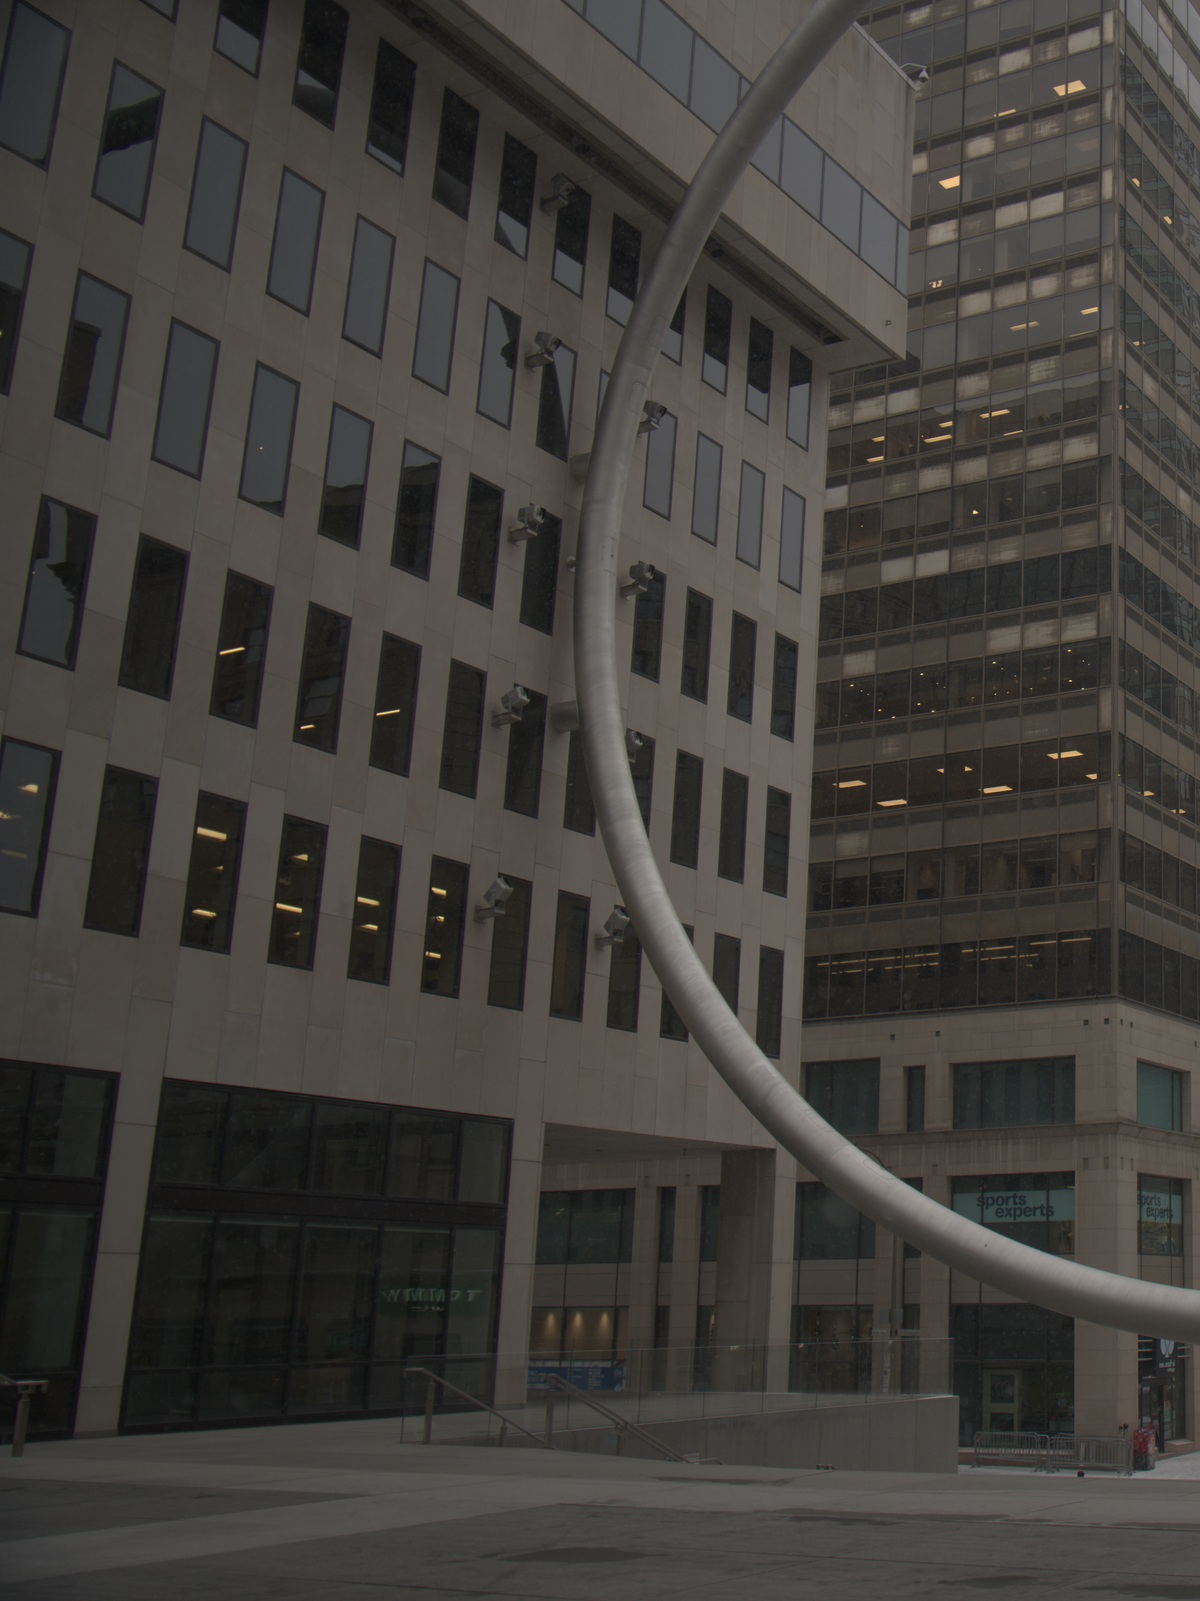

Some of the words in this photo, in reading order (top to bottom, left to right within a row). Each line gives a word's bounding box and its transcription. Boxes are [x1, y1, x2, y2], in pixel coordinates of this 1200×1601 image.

[976, 1193, 1027, 1210] sports
[1137, 1194, 1161, 1208] sports
[995, 1204, 1054, 1221] experts
[1146, 1207, 1173, 1220] experts
